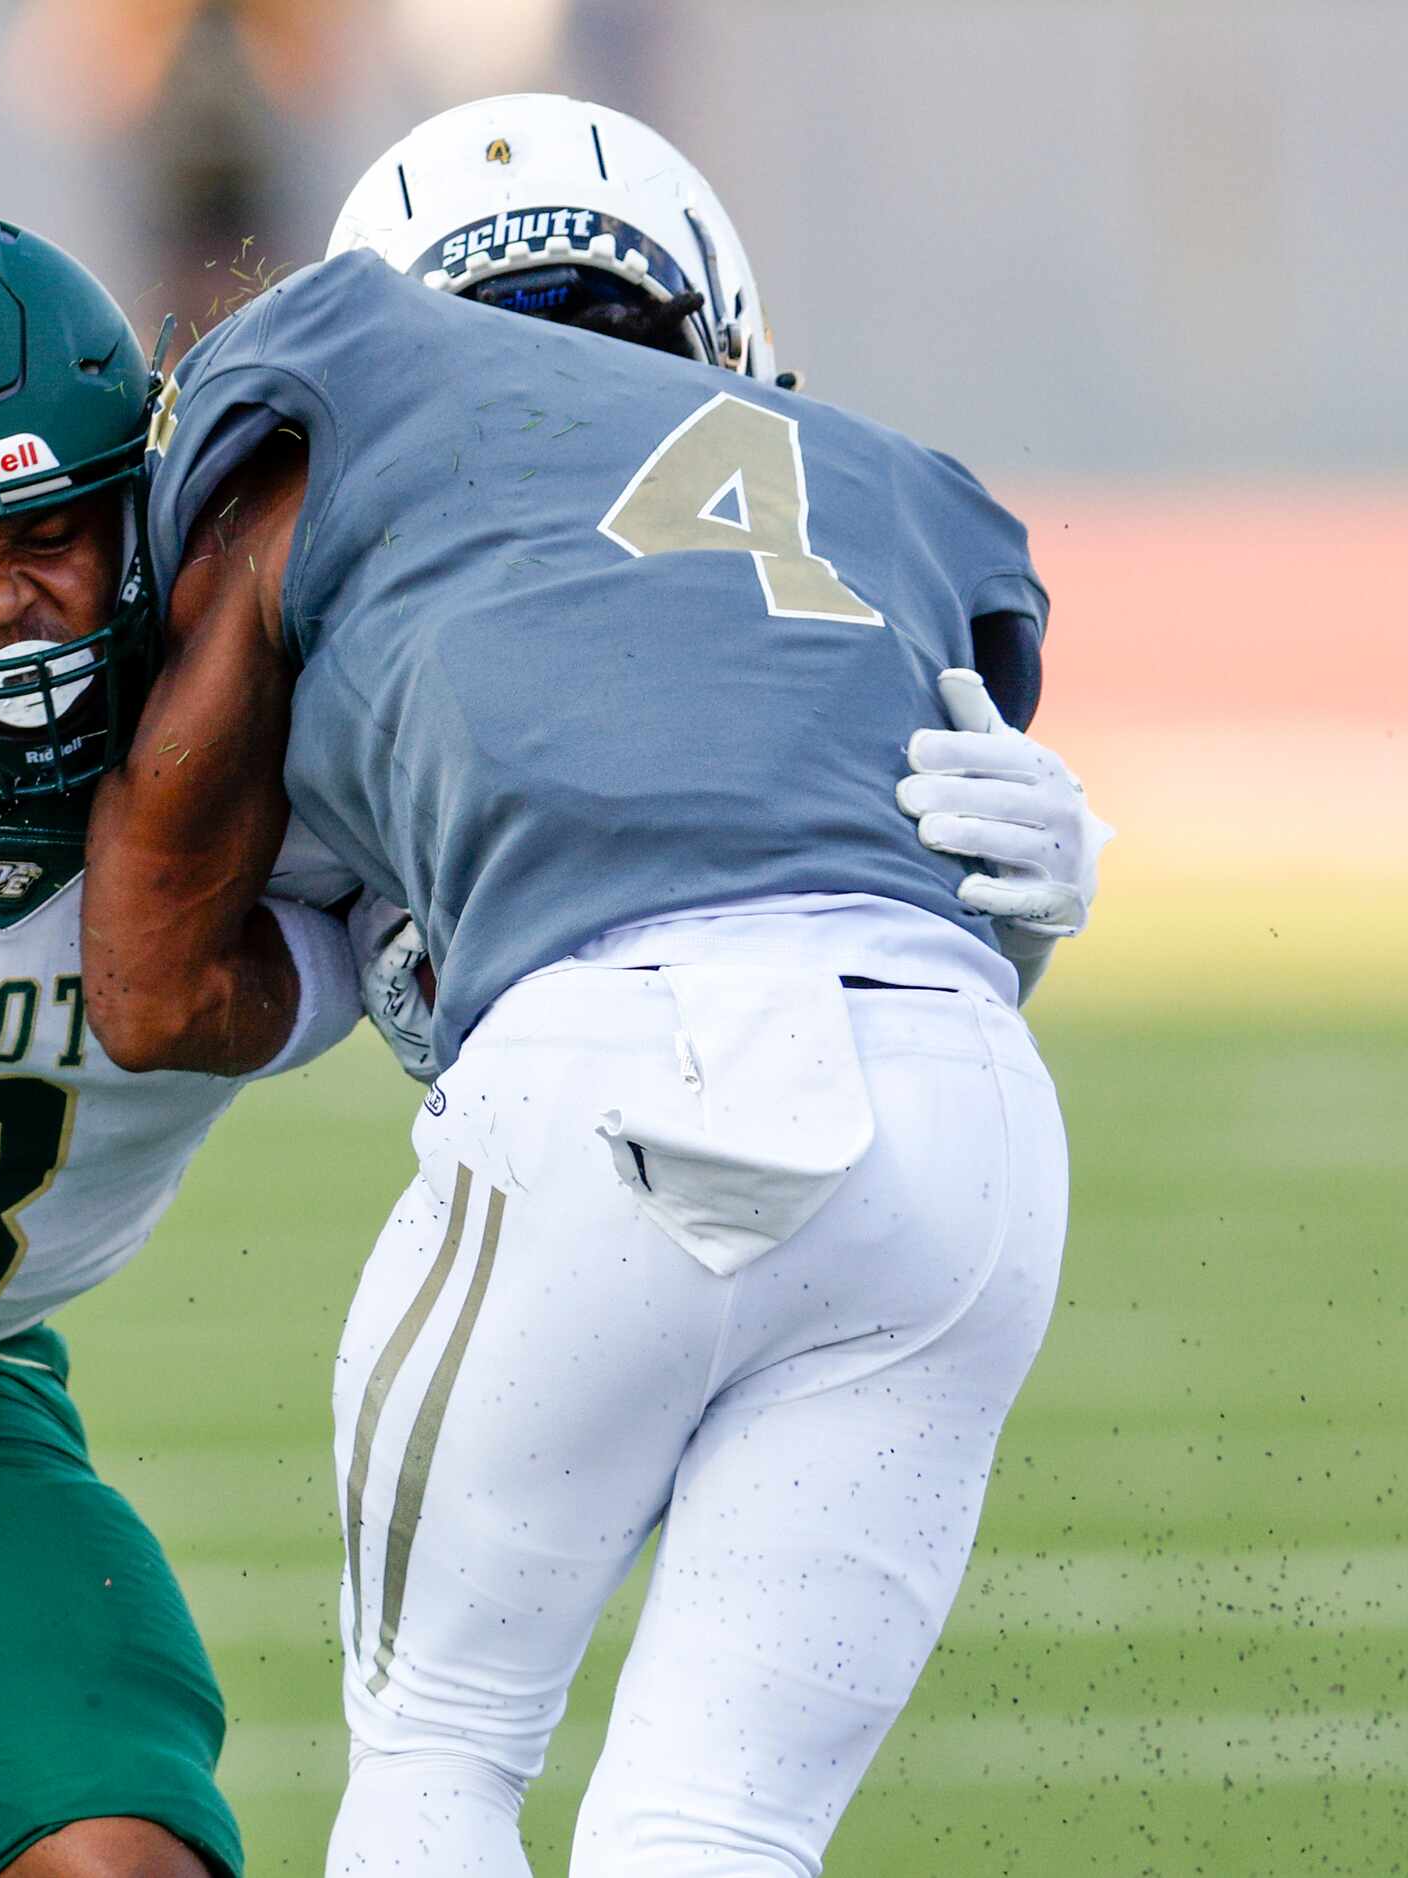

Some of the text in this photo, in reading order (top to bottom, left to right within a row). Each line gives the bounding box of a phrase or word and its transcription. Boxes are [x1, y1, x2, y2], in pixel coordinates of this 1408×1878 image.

[486, 138, 511, 165] 4
[443, 209, 593, 267] schutt
[500, 287, 570, 311] chutt
[597, 391, 885, 626] 4
[25, 736, 82, 763] Ridell
